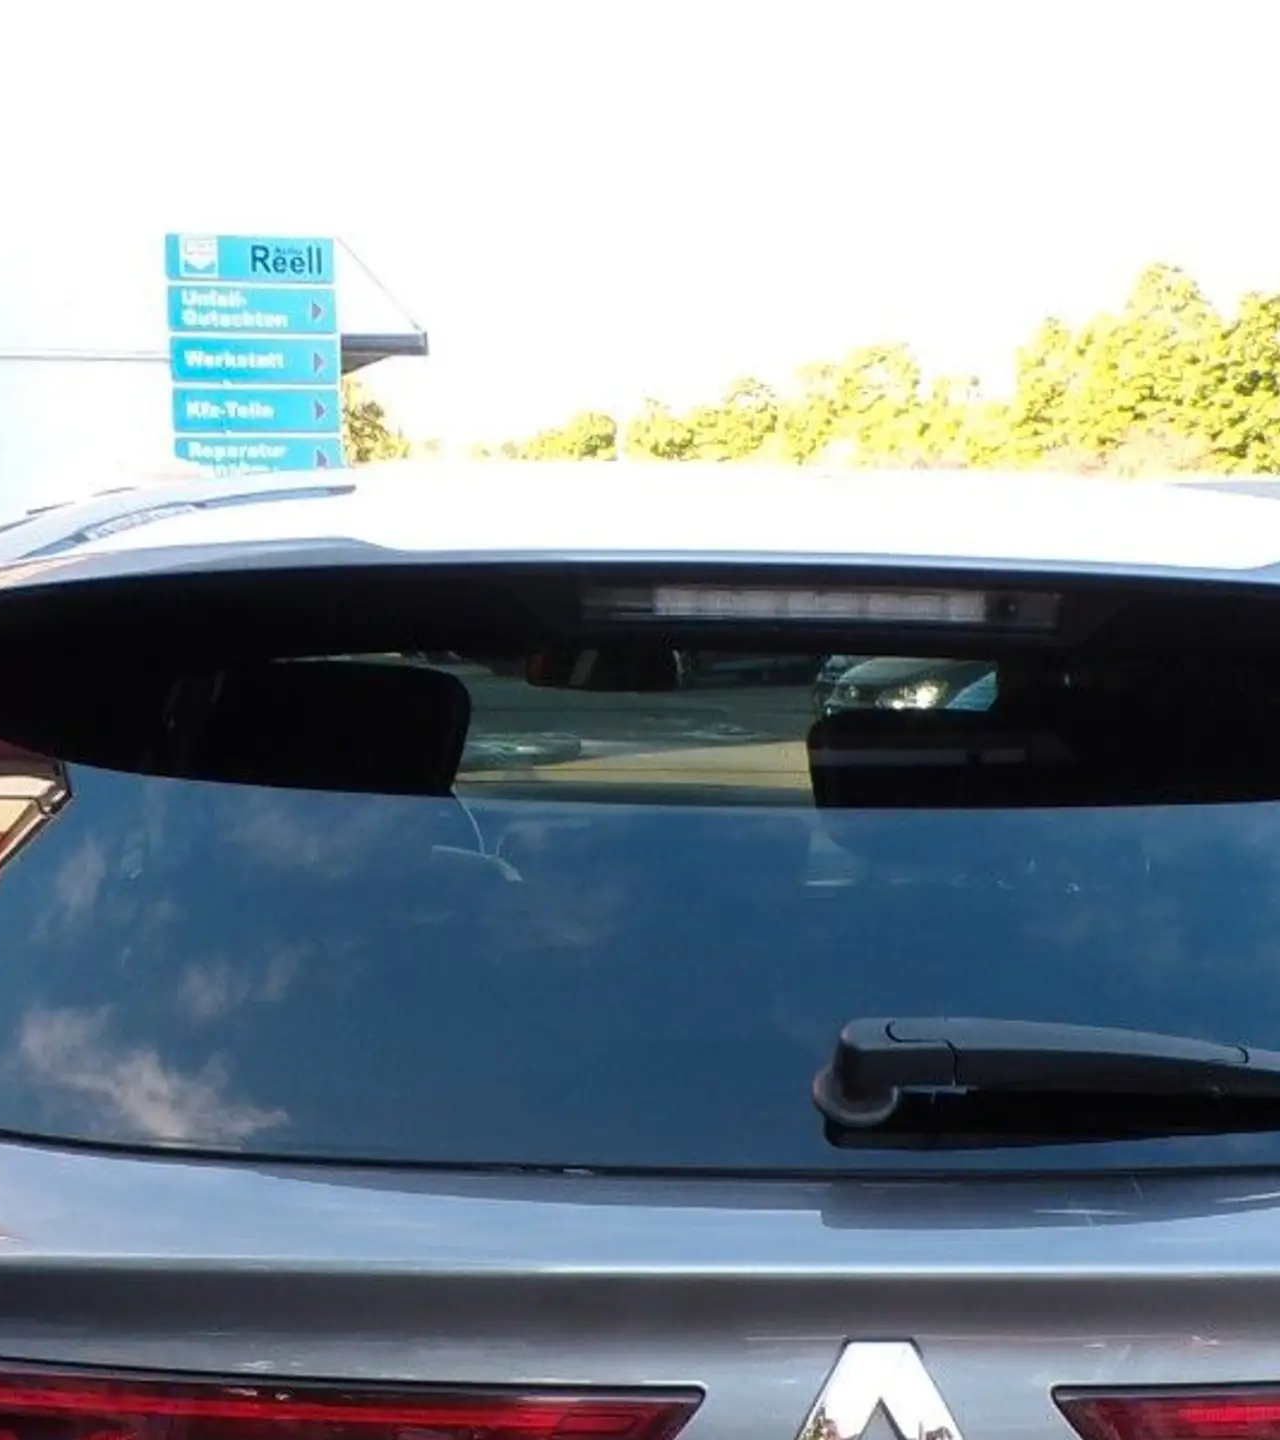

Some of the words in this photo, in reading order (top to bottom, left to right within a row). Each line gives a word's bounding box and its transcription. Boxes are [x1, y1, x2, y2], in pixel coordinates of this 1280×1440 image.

[251, 245, 322, 275] Reell
[181, 309, 289, 329] Gutachten
[183, 350, 285, 370] Werkstatt
